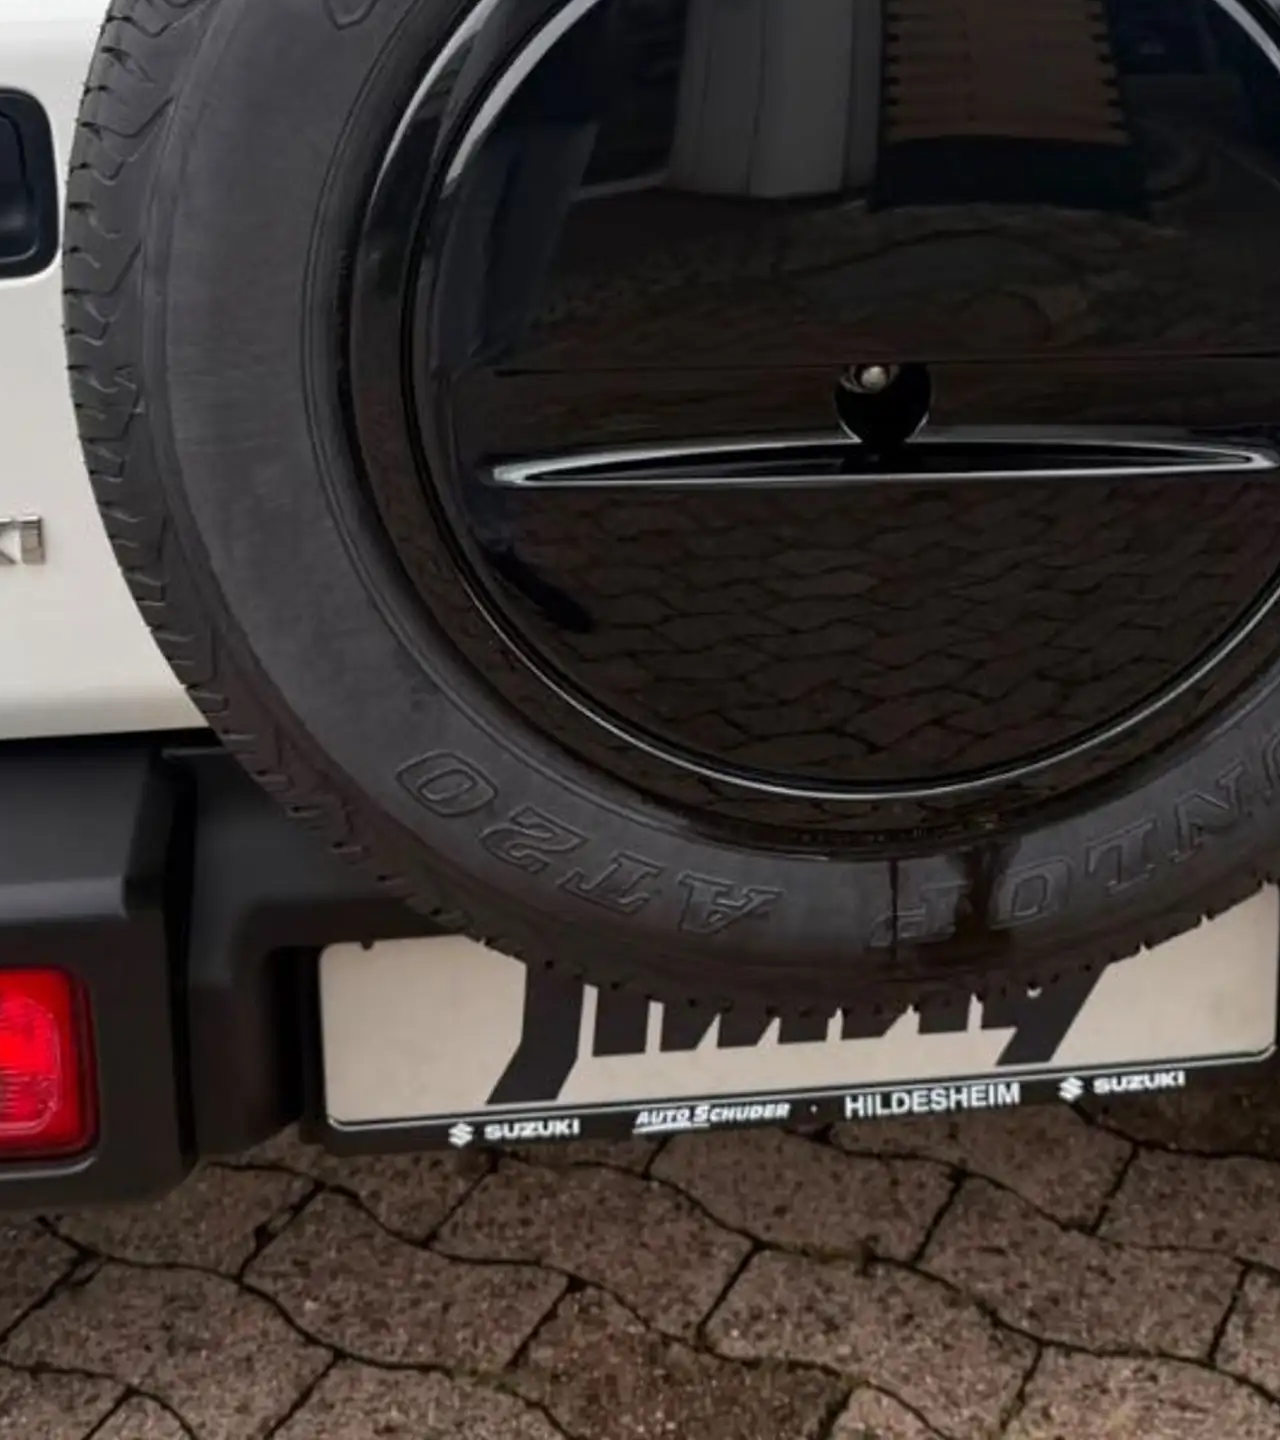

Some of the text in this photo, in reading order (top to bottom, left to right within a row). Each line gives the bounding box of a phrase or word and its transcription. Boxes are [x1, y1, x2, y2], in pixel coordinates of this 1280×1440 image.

[396, 748, 783, 938] AT20
[484, 1117, 581, 1143] SUZUKI
[635, 1107, 690, 1126] AUTO
[844, 1081, 1021, 1120] HILDESHEIM
[1093, 1069, 1186, 1095] SUZUKI
